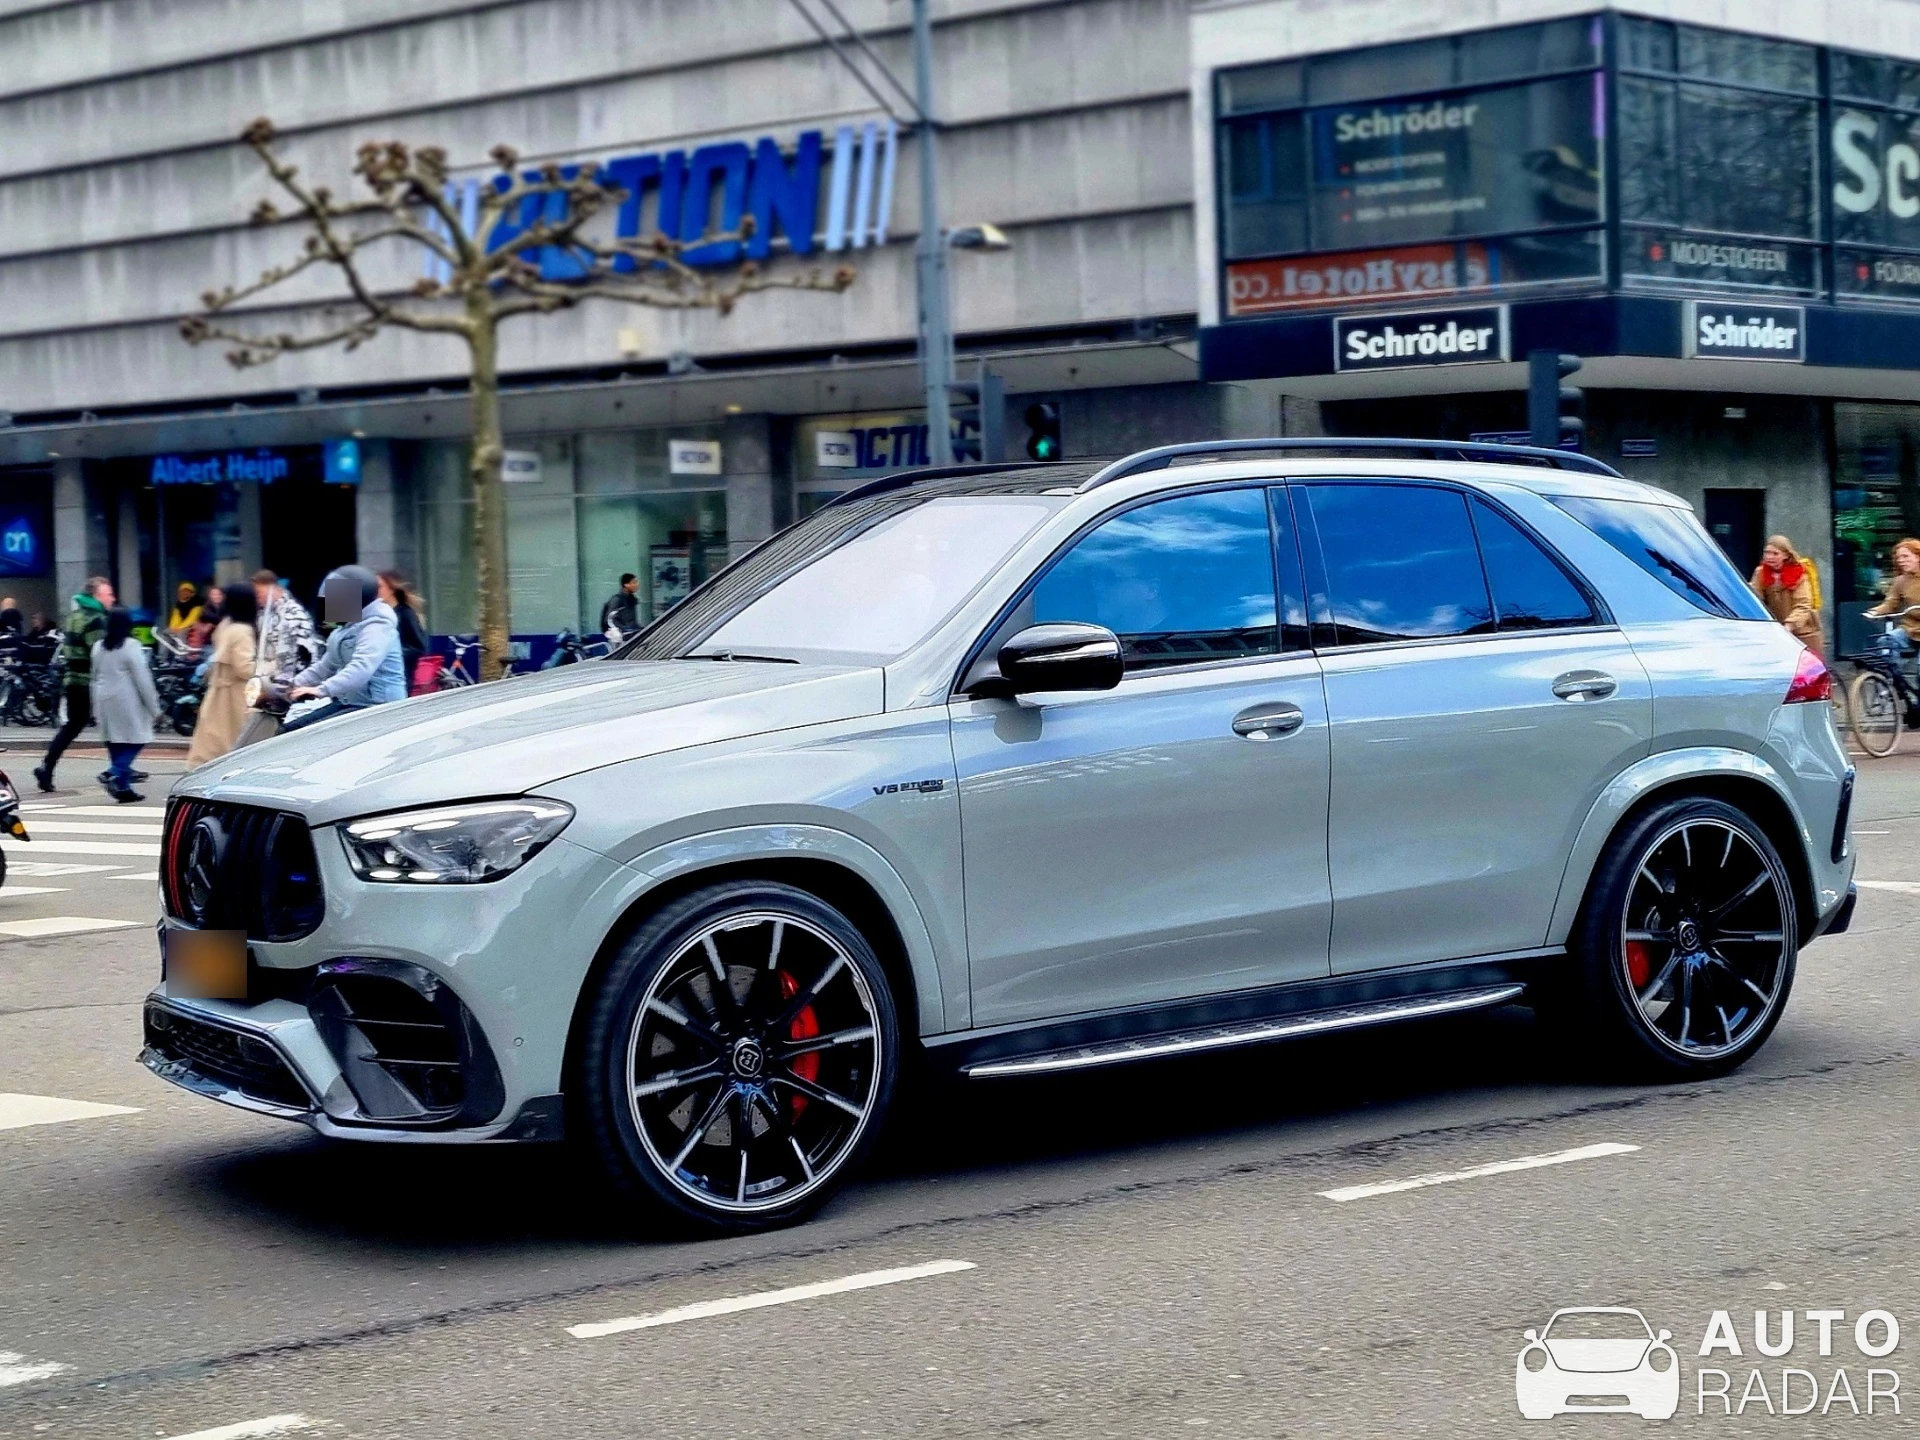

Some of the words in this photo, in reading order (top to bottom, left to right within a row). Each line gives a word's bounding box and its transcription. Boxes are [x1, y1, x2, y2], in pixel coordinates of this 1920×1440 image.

[1335, 102, 1479, 142] Schröder
[1671, 242, 1787, 272] MODESTOFFEN
[1346, 322, 1494, 360] Schröder
[1699, 314, 1798, 350] Schröder
[152, 457, 220, 483] Albert
[228, 450, 287, 484] Heijn
